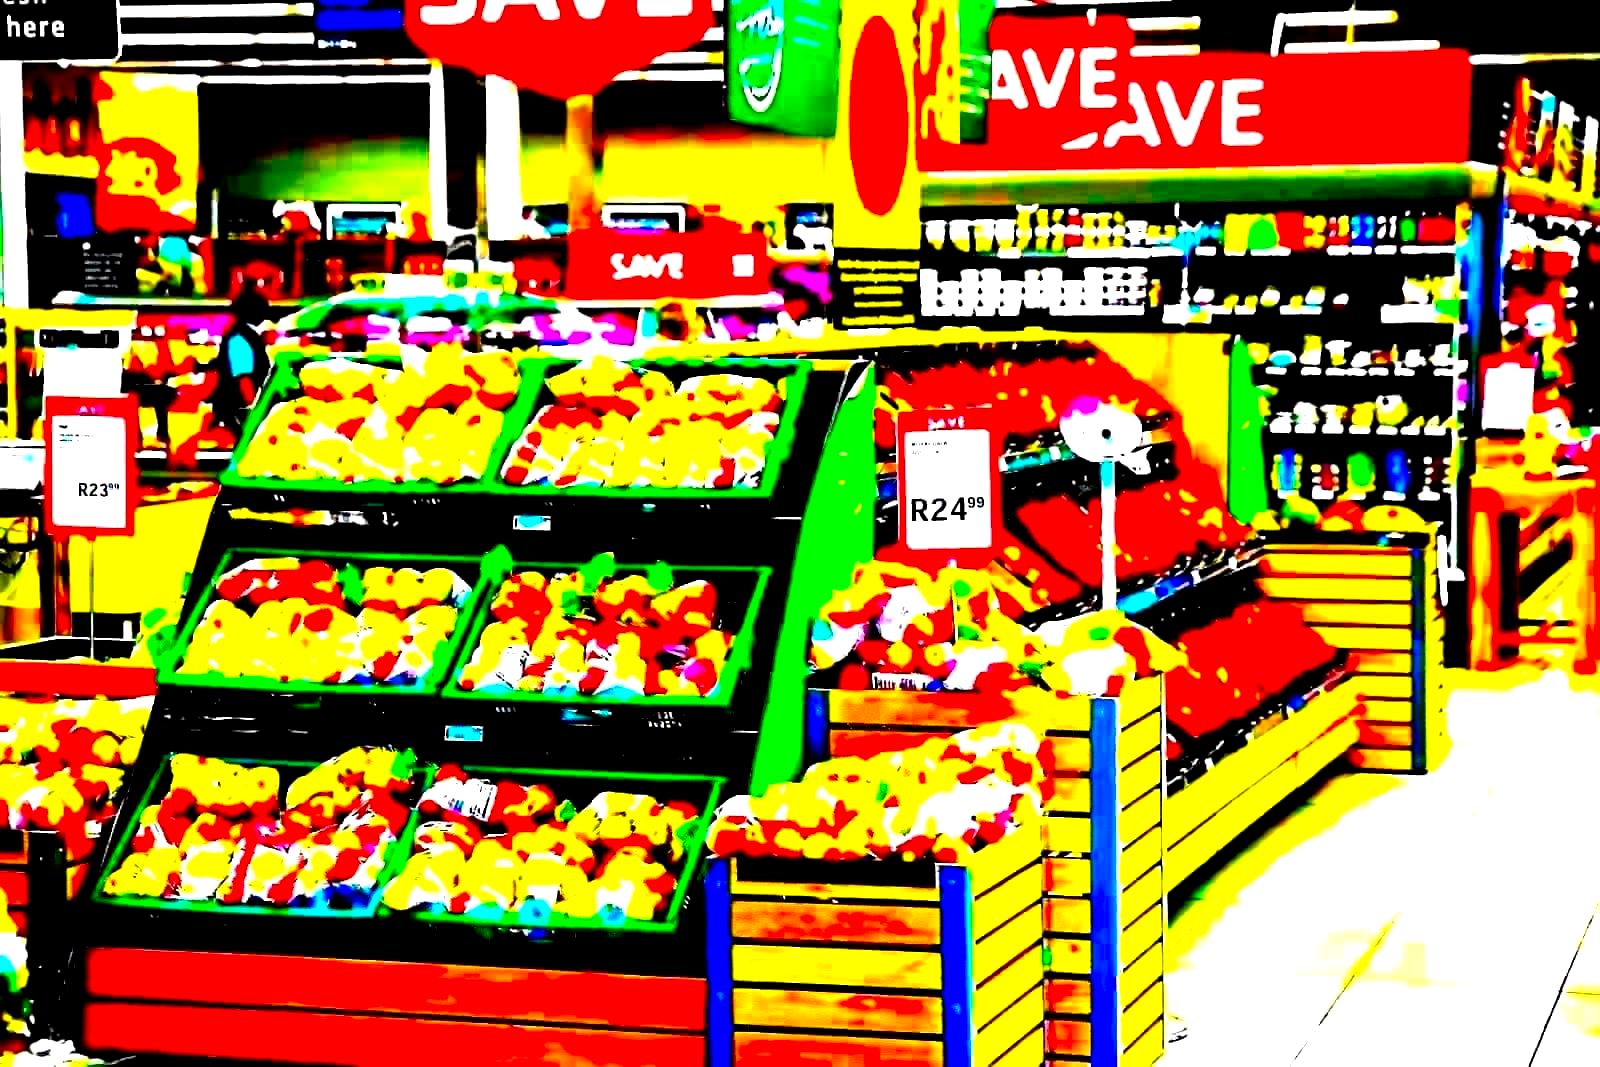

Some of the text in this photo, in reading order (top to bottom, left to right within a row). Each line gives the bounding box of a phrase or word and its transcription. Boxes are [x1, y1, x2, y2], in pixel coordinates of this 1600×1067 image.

[7, 14, 64, 38] here
[992, 46, 1118, 110] AVE
[1061, 78, 1265, 150] AVE
[610, 252, 684, 280] SAVE
